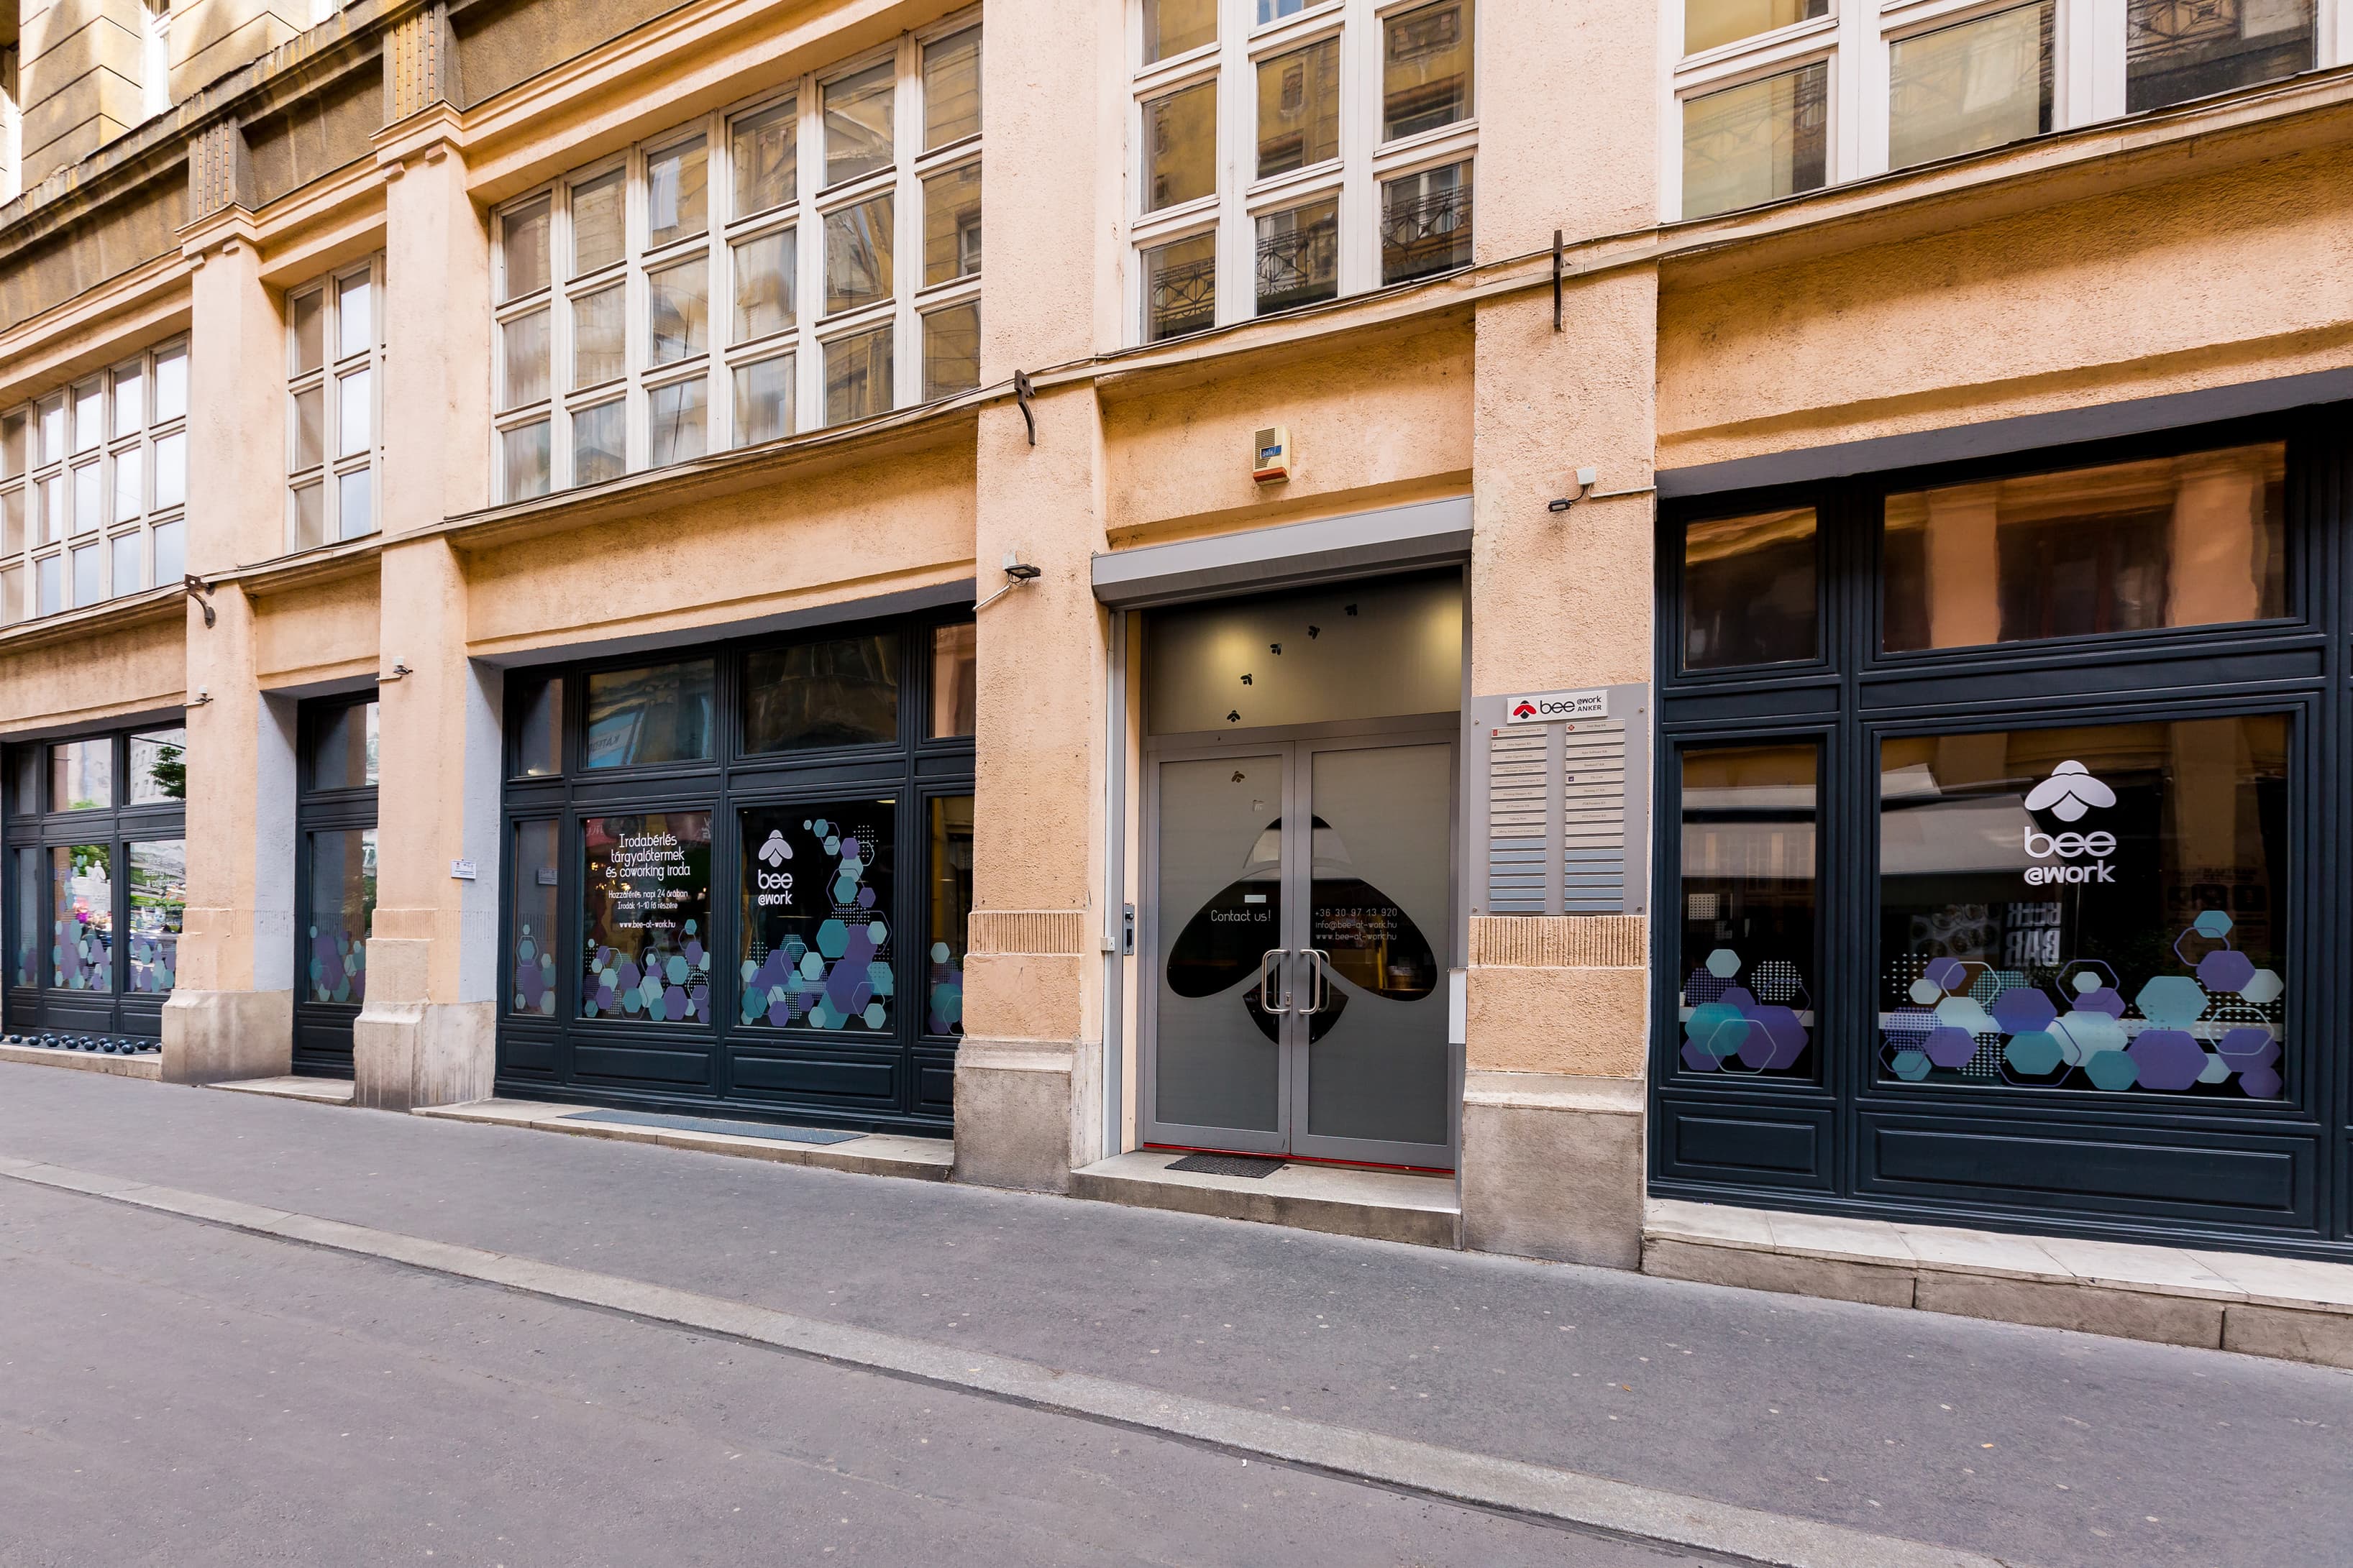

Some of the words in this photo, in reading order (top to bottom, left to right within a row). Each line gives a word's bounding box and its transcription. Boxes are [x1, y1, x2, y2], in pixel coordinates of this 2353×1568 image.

[1540, 700, 1576, 715] bee
[1576, 695, 1602, 705] @work
[618, 831, 677, 848] Irodabérlés
[2024, 826, 2117, 858] bee
[611, 846, 685, 867] tárgyalótermek
[606, 866, 617, 878] és
[619, 863, 665, 881] coworking
[667, 861, 691, 876] iroda
[757, 868, 793, 889] bee
[2024, 859, 2116, 886] @work
[608, 890, 641, 899] Hozzáférés
[643, 891, 656, 900] napi
[657, 889, 665, 898] 24
[666, 889, 688, 898] órában
[757, 890, 793, 906] @work
[1211, 909, 1251, 922] Contact
[1254, 909, 1271, 922] us!
[1315, 908, 1331, 917] +36
[1335, 908, 1346, 917] 30
[1351, 908, 1362, 917] 97
[1366, 908, 1377, 917] 13
[1381, 908, 1397, 917] 920
[1315, 920, 1397, 930] info@bee-at-work.hu
[1315, 932, 1397, 940] www.bee-at-work.hu
